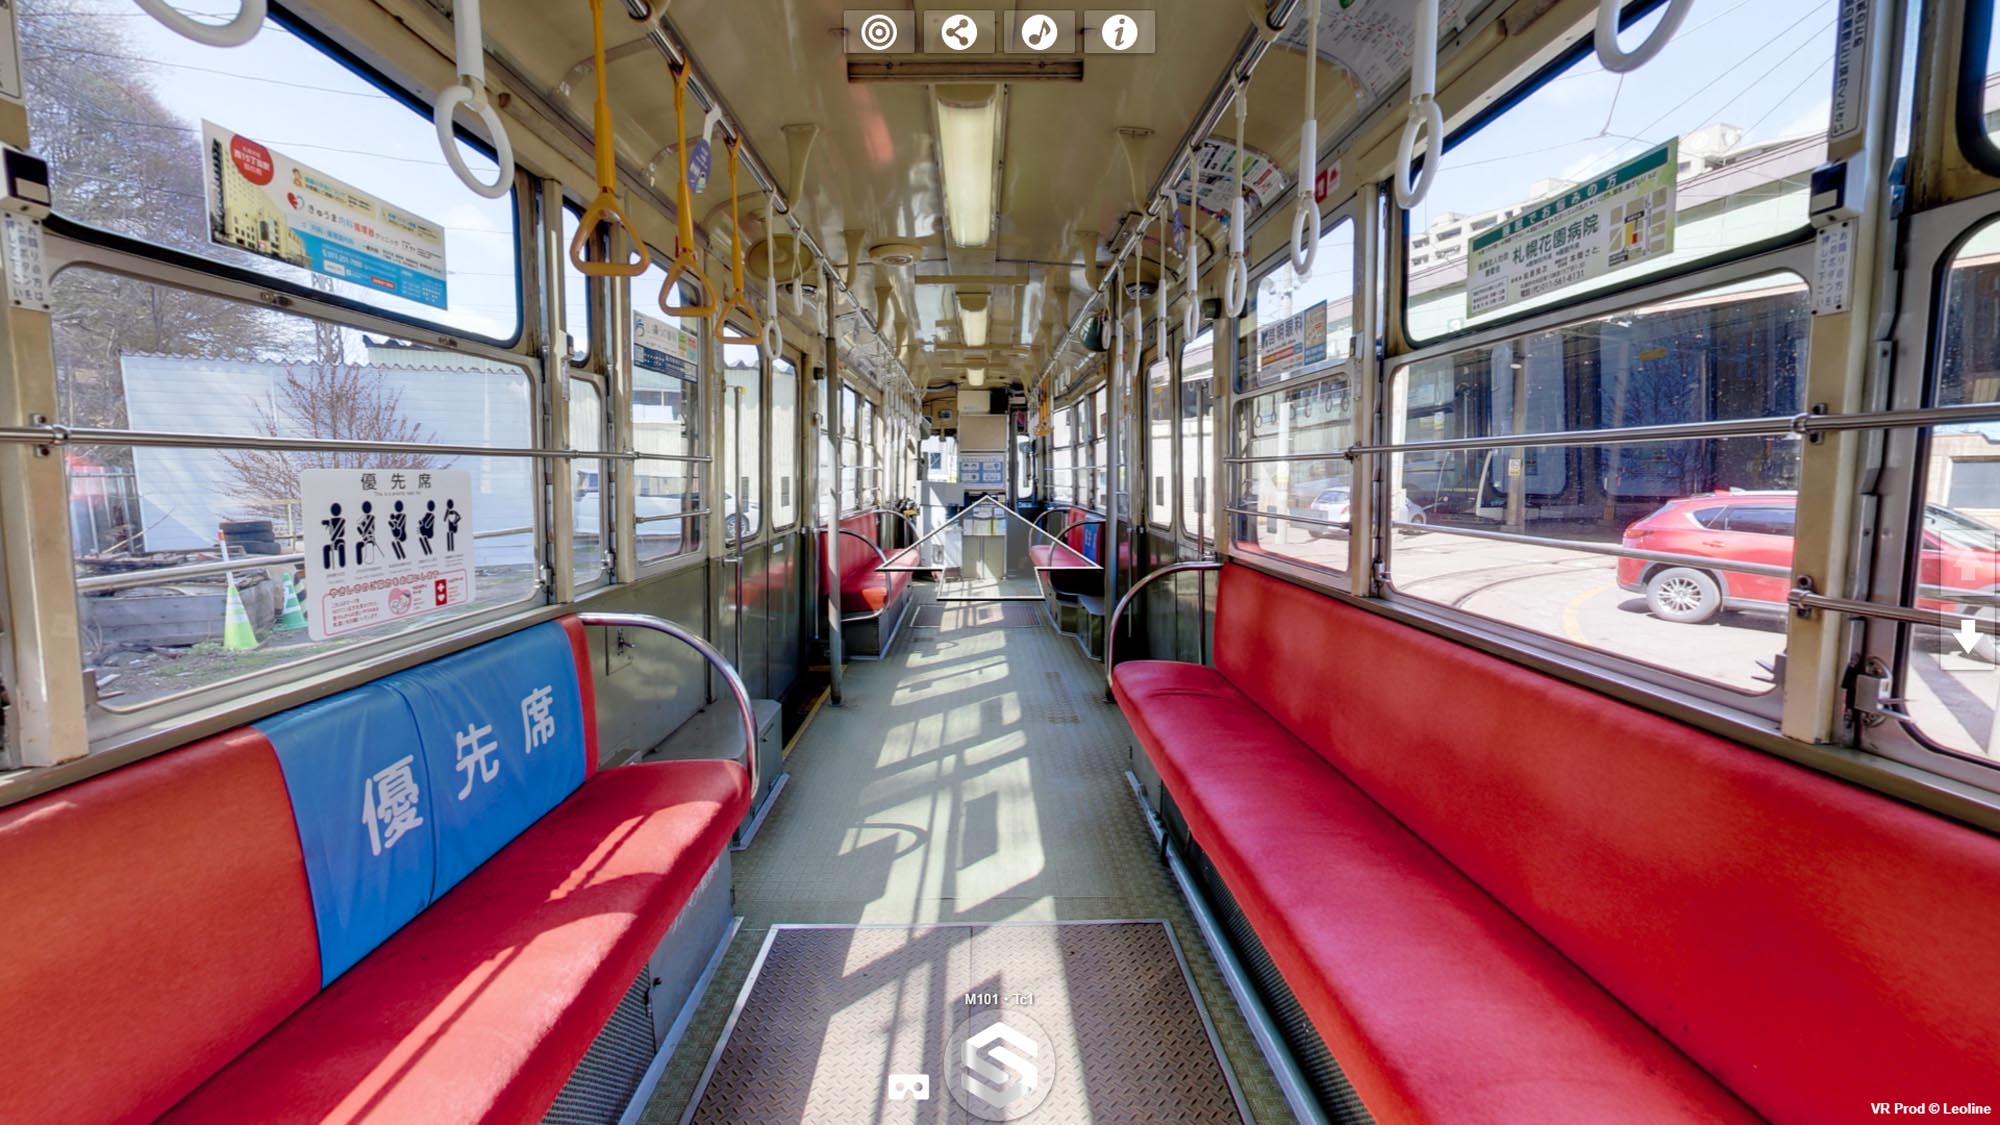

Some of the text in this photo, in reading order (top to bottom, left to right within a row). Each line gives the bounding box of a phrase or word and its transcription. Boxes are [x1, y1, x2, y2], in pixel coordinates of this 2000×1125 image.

[1512, 213, 1600, 265] 札幌花園病院
[361, 473, 432, 491] 優先席
[361, 684, 555, 857] 優先席
